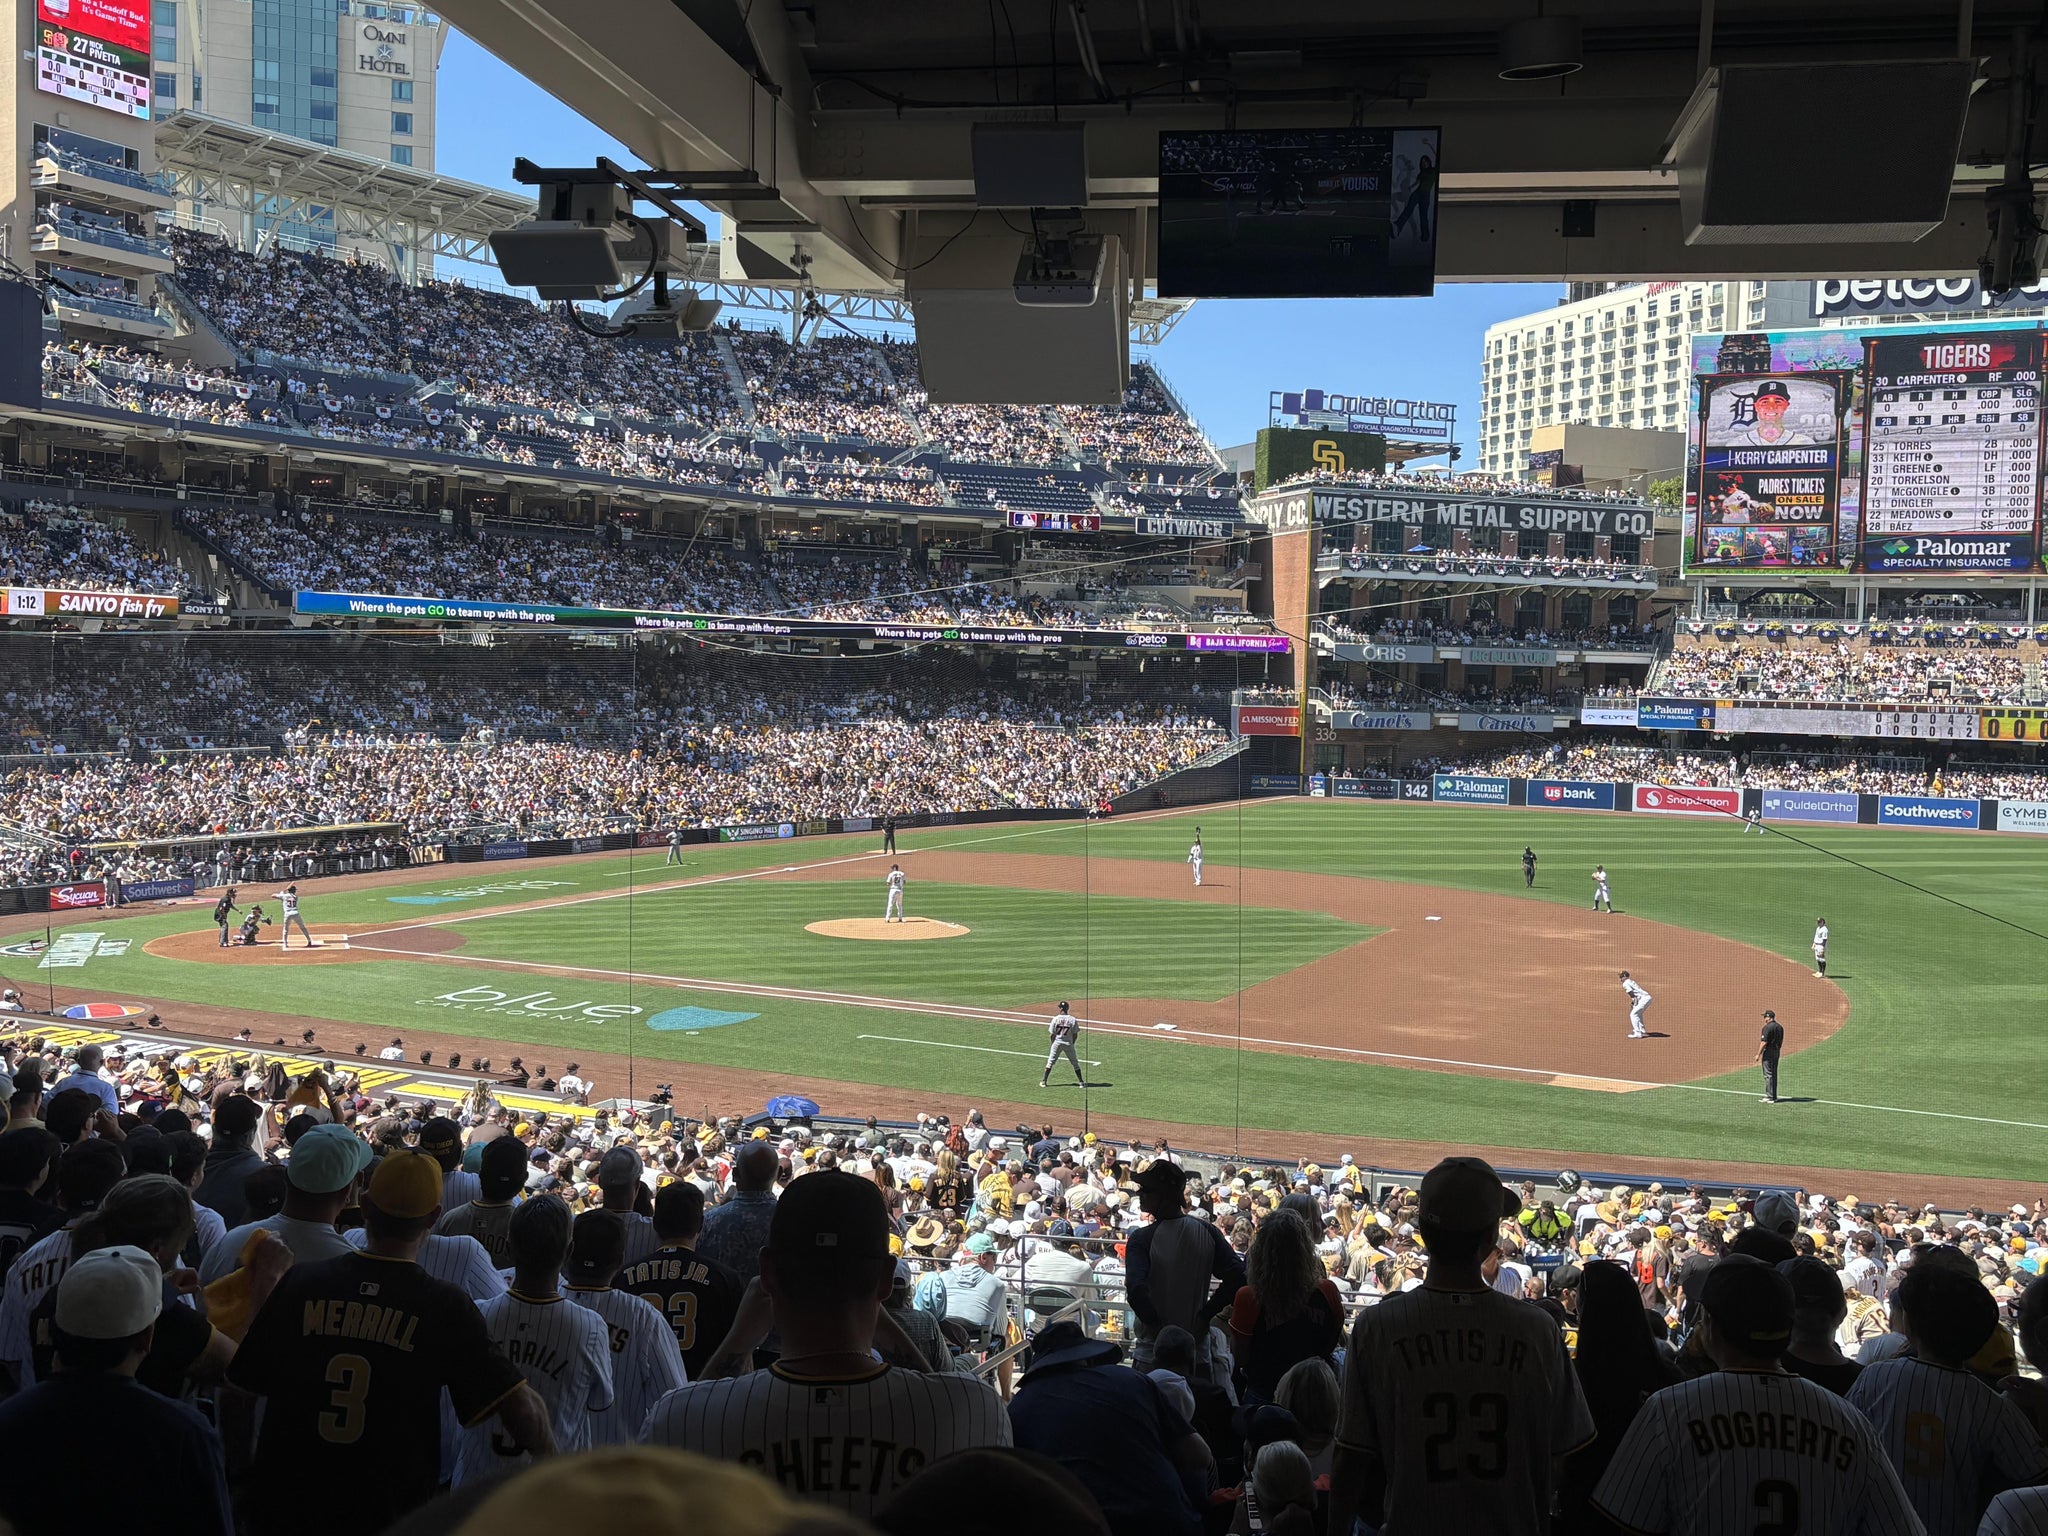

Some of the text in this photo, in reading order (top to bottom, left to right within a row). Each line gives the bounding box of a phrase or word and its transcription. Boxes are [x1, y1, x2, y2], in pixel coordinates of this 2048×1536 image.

[82, 5, 138, 28] It's Game Time
[100, 1, 146, 22] Leadoff Bud.
[364, 25, 406, 44] OMNI
[73, 36, 88, 54] 27
[89, 40, 103, 50] NICK
[89, 48, 120, 65] PIVETTA
[360, 55, 410, 74] HOTEL
[48, 60, 115, 88] 0.0 0/0
[1342, 177, 1378, 190] YOURS!
[1924, 344, 1990, 368] TIGERS
[1876, 371, 2036, 386] 30 CARPENTER RF .000
[1981, 390, 1997, 398] OBP
[2017, 389, 2032, 397] SLG
[1329, 394, 1450, 420] QuidelOrtho
[1978, 399, 2034, 409] .000 .000
[2018, 413, 2028, 421] SB
[1380, 425, 1418, 434] DIAGNOSTICS
[1873, 439, 2032, 450] 25 TORRES 2B .000
[1735, 450, 1827, 465] KERRY CARPENTER
[1872, 450, 2031, 462] 33 KEITH DH .000
[1873, 462, 2031, 474] 31 GREENE LF .000
[1759, 478, 1824, 494] PADRES TICKETS
[1871, 474, 2030, 485] 20 TORKELSON 1B .000
[1874, 486, 2029, 496] 7 McGONIGLE 3B .000
[1872, 497, 2028, 508] 13 DINGLER C .000
[1287, 500, 1308, 526] CO.
[1313, 496, 1651, 535] WESTERN METAL SUPPLY CO.
[1775, 506, 1823, 520] NOW
[1870, 509, 2028, 519] 22 MEADOWS CF .000
[1148, 519, 1222, 537] CUTWATER
[1890, 521, 1912, 531] BÁEZ
[1981, 521, 1993, 529] SS
[2005, 521, 2028, 529] .000
[1916, 538, 2011, 555] Palomar
[18, 595, 36, 609] 1:12
[59, 595, 165, 618] SANYO fish fry
[185, 606, 213, 614] SONY
[350, 601, 555, 622] Where the pets GO to team up with the pros
[635, 616, 791, 634] Where the pets GO to team up with the pros
[875, 628, 1062, 643] Where the pets GO to team up with the pros
[1139, 634, 1167, 645] petco
[1226, 638, 1267, 647] CALIFORNIA
[1363, 645, 1406, 661] ORIS
[1654, 705, 1694, 715] Palomar
[1351, 712, 1413, 730] Canel's
[1967, 716, 1972, 725] 2
[1316, 728, 1336, 741] 336
[1967, 728, 1972, 738] 2
[1988, 719, 2025, 739] 0 0
[1405, 784, 1428, 798] 342
[1455, 780, 1504, 793] Palomar
[1546, 787, 1595, 800] us bank
[1666, 794, 1729, 808] Snapdragon
[1784, 799, 1853, 812] QuidelOrtho
[1884, 804, 1961, 819] Southwest
[740, 826, 764, 835] SINGING
[58, 887, 98, 904] Sycuan
[128, 883, 182, 898] Southwest
[434, 985, 643, 1018] blue
[415, 1000, 605, 1025] CALIFORNIA
[1056, 1026, 1070, 1035] 77
[938, 1189, 956, 1207] 23
[624, 1260, 710, 1286] TATIS JR.
[302, 1300, 419, 1352] MERRILL
[1393, 1329, 1528, 1374] TATIS JR
[318, 1353, 372, 1444] 3
[1423, 1393, 1508, 1483] 23
[1686, 1411, 1856, 1472] BOGAERTS
[1905, 1411, 1946, 1479] 9
